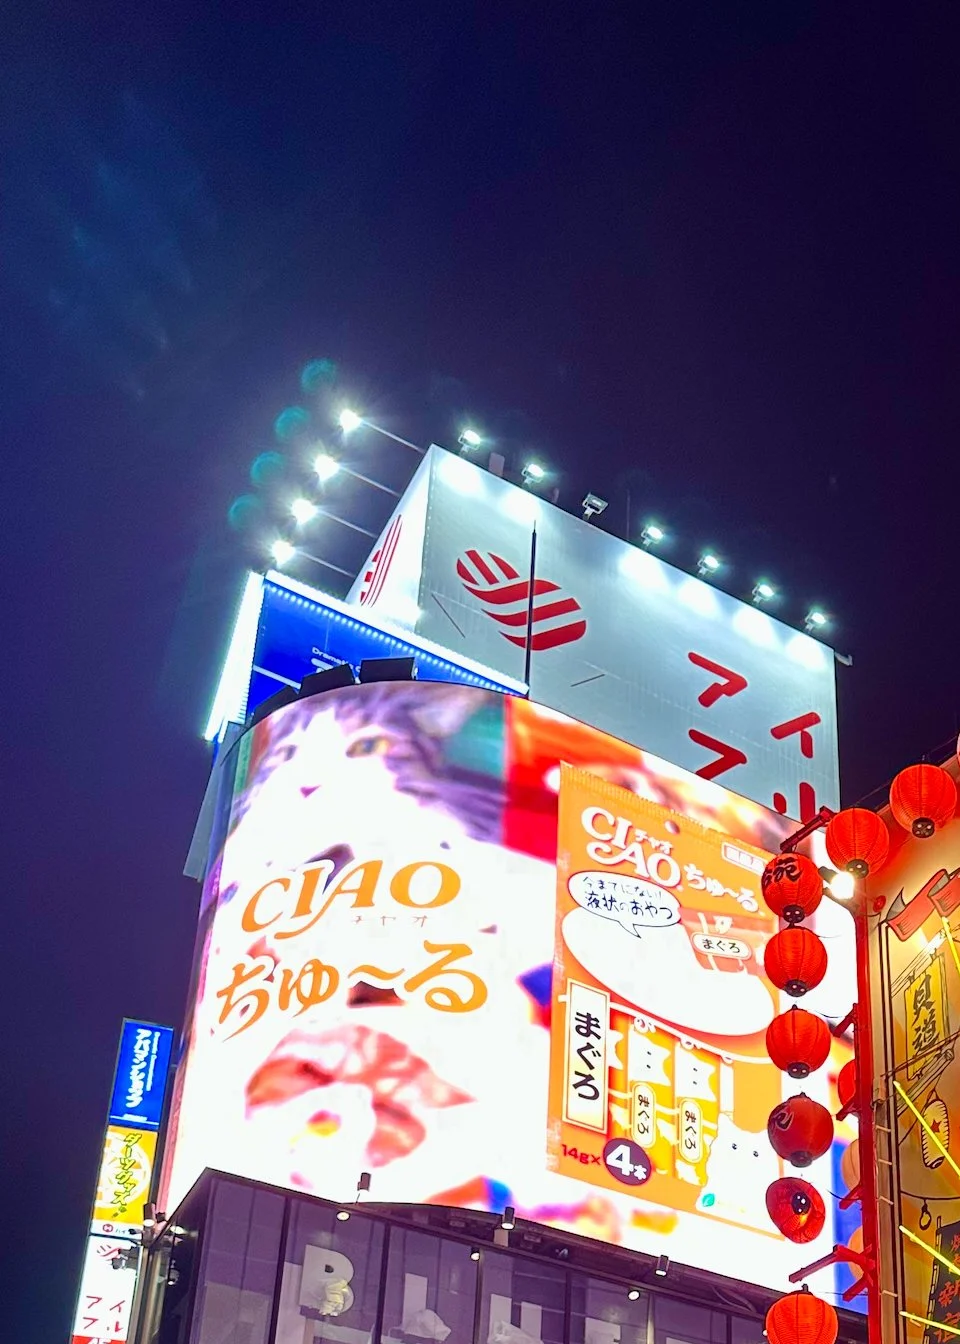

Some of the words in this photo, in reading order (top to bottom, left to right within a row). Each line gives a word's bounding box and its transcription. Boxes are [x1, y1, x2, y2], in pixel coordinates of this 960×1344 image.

[241, 860, 461, 939] CIAO
[702, 938, 741, 954] まぐろ
[572, 1010, 601, 1101] まぐろ
[637, 1094, 650, 1135] まぐろ
[684, 1109, 697, 1150] まぐろ
